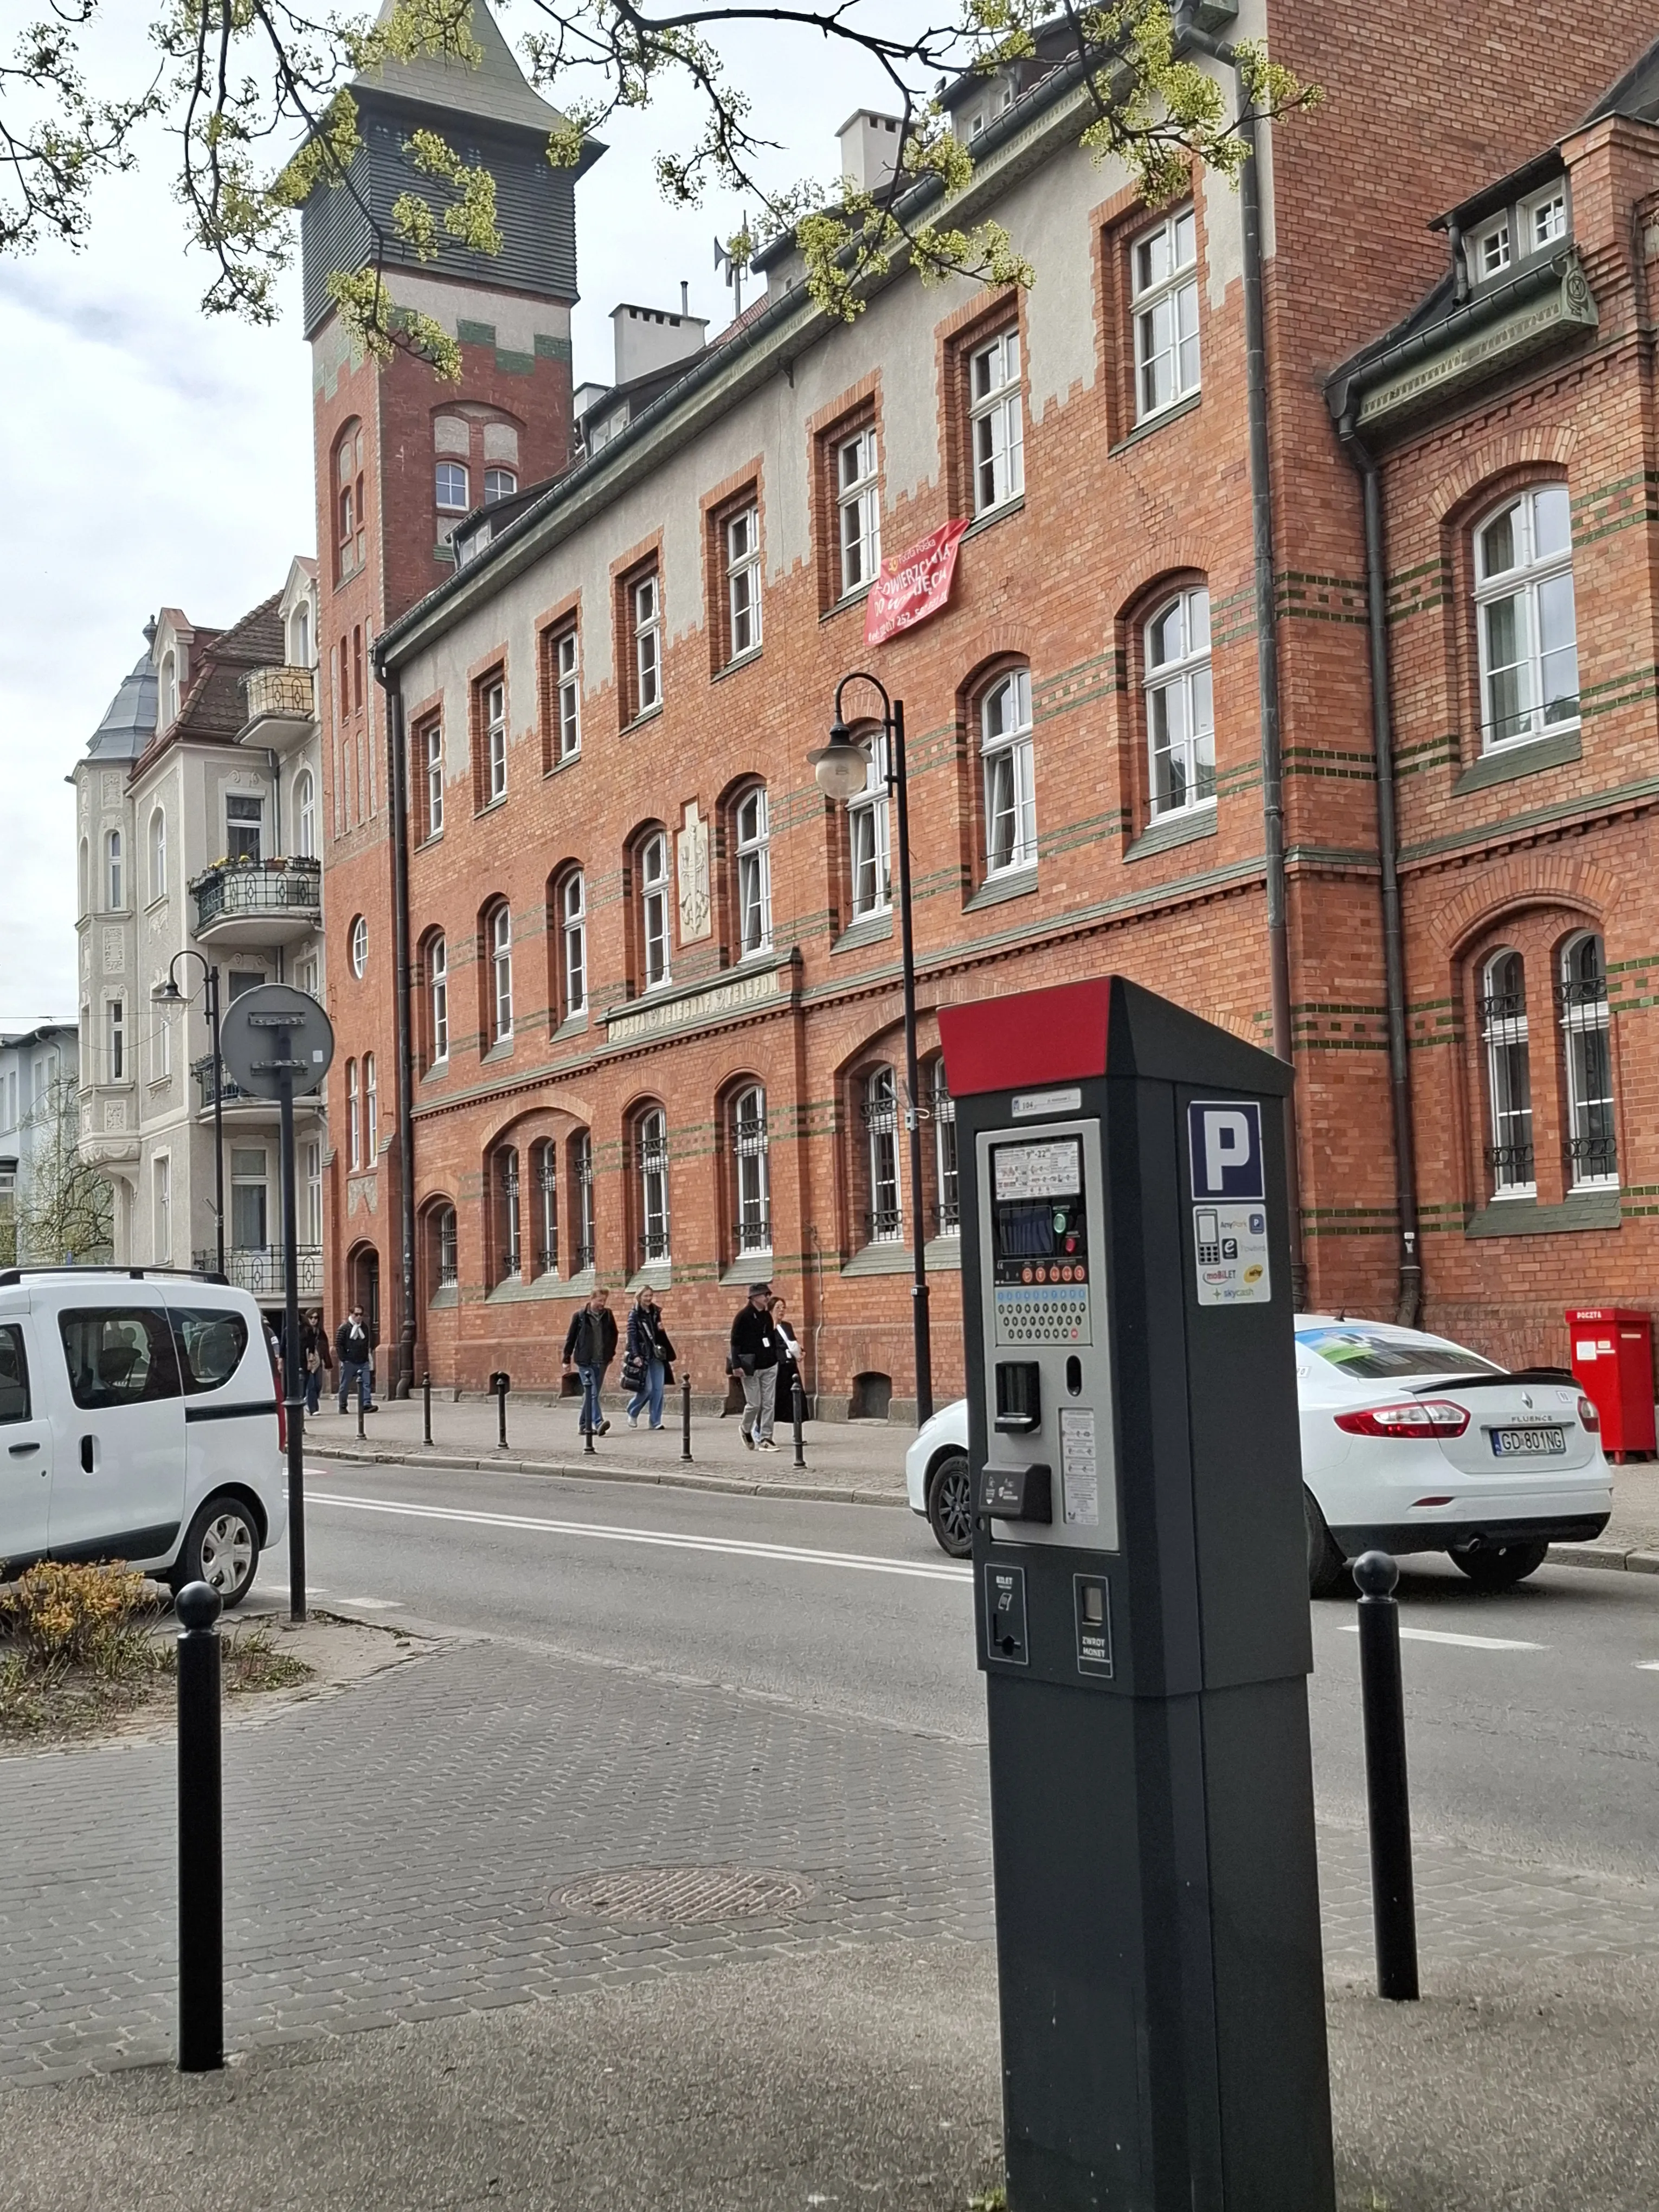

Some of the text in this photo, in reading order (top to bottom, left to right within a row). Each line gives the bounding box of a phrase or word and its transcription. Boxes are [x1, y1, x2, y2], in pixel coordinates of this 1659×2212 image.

[874, 597, 885, 618] DO
[609, 972, 779, 1041] POCZTA TELEGRAF TELEFON
[1204, 1111, 1250, 1191] P
[1224, 1288, 1253, 1299] skycash
[1577, 1311, 1602, 1319] POCZTA
[1502, 1431, 1562, 1450] GD 801NG
[996, 1576, 1013, 1585] BILET
[1082, 1636, 1105, 1647] ZWROT
[1083, 1647, 1105, 1657] MONET
